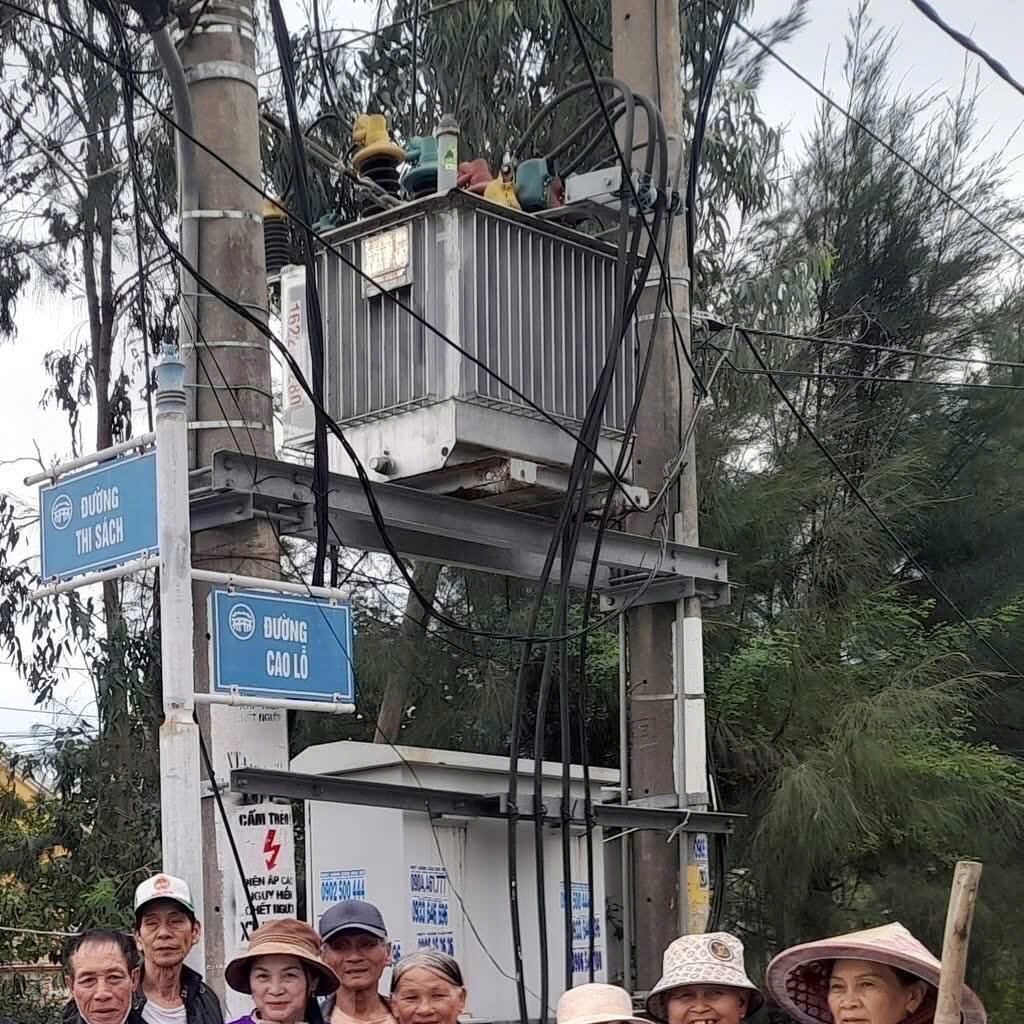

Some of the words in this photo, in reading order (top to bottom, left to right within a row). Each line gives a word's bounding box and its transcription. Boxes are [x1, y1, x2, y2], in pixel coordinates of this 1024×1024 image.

[80, 485, 119, 519] ĐƯỜNG
[75, 526, 93, 555] THI
[95, 515, 124, 550] SÁCH
[263, 613, 308, 643] ĐƯỜNG
[266, 649, 291, 678] CAO
[293, 644, 309, 680] LỖ
[239, 809, 266, 826] CẤM
